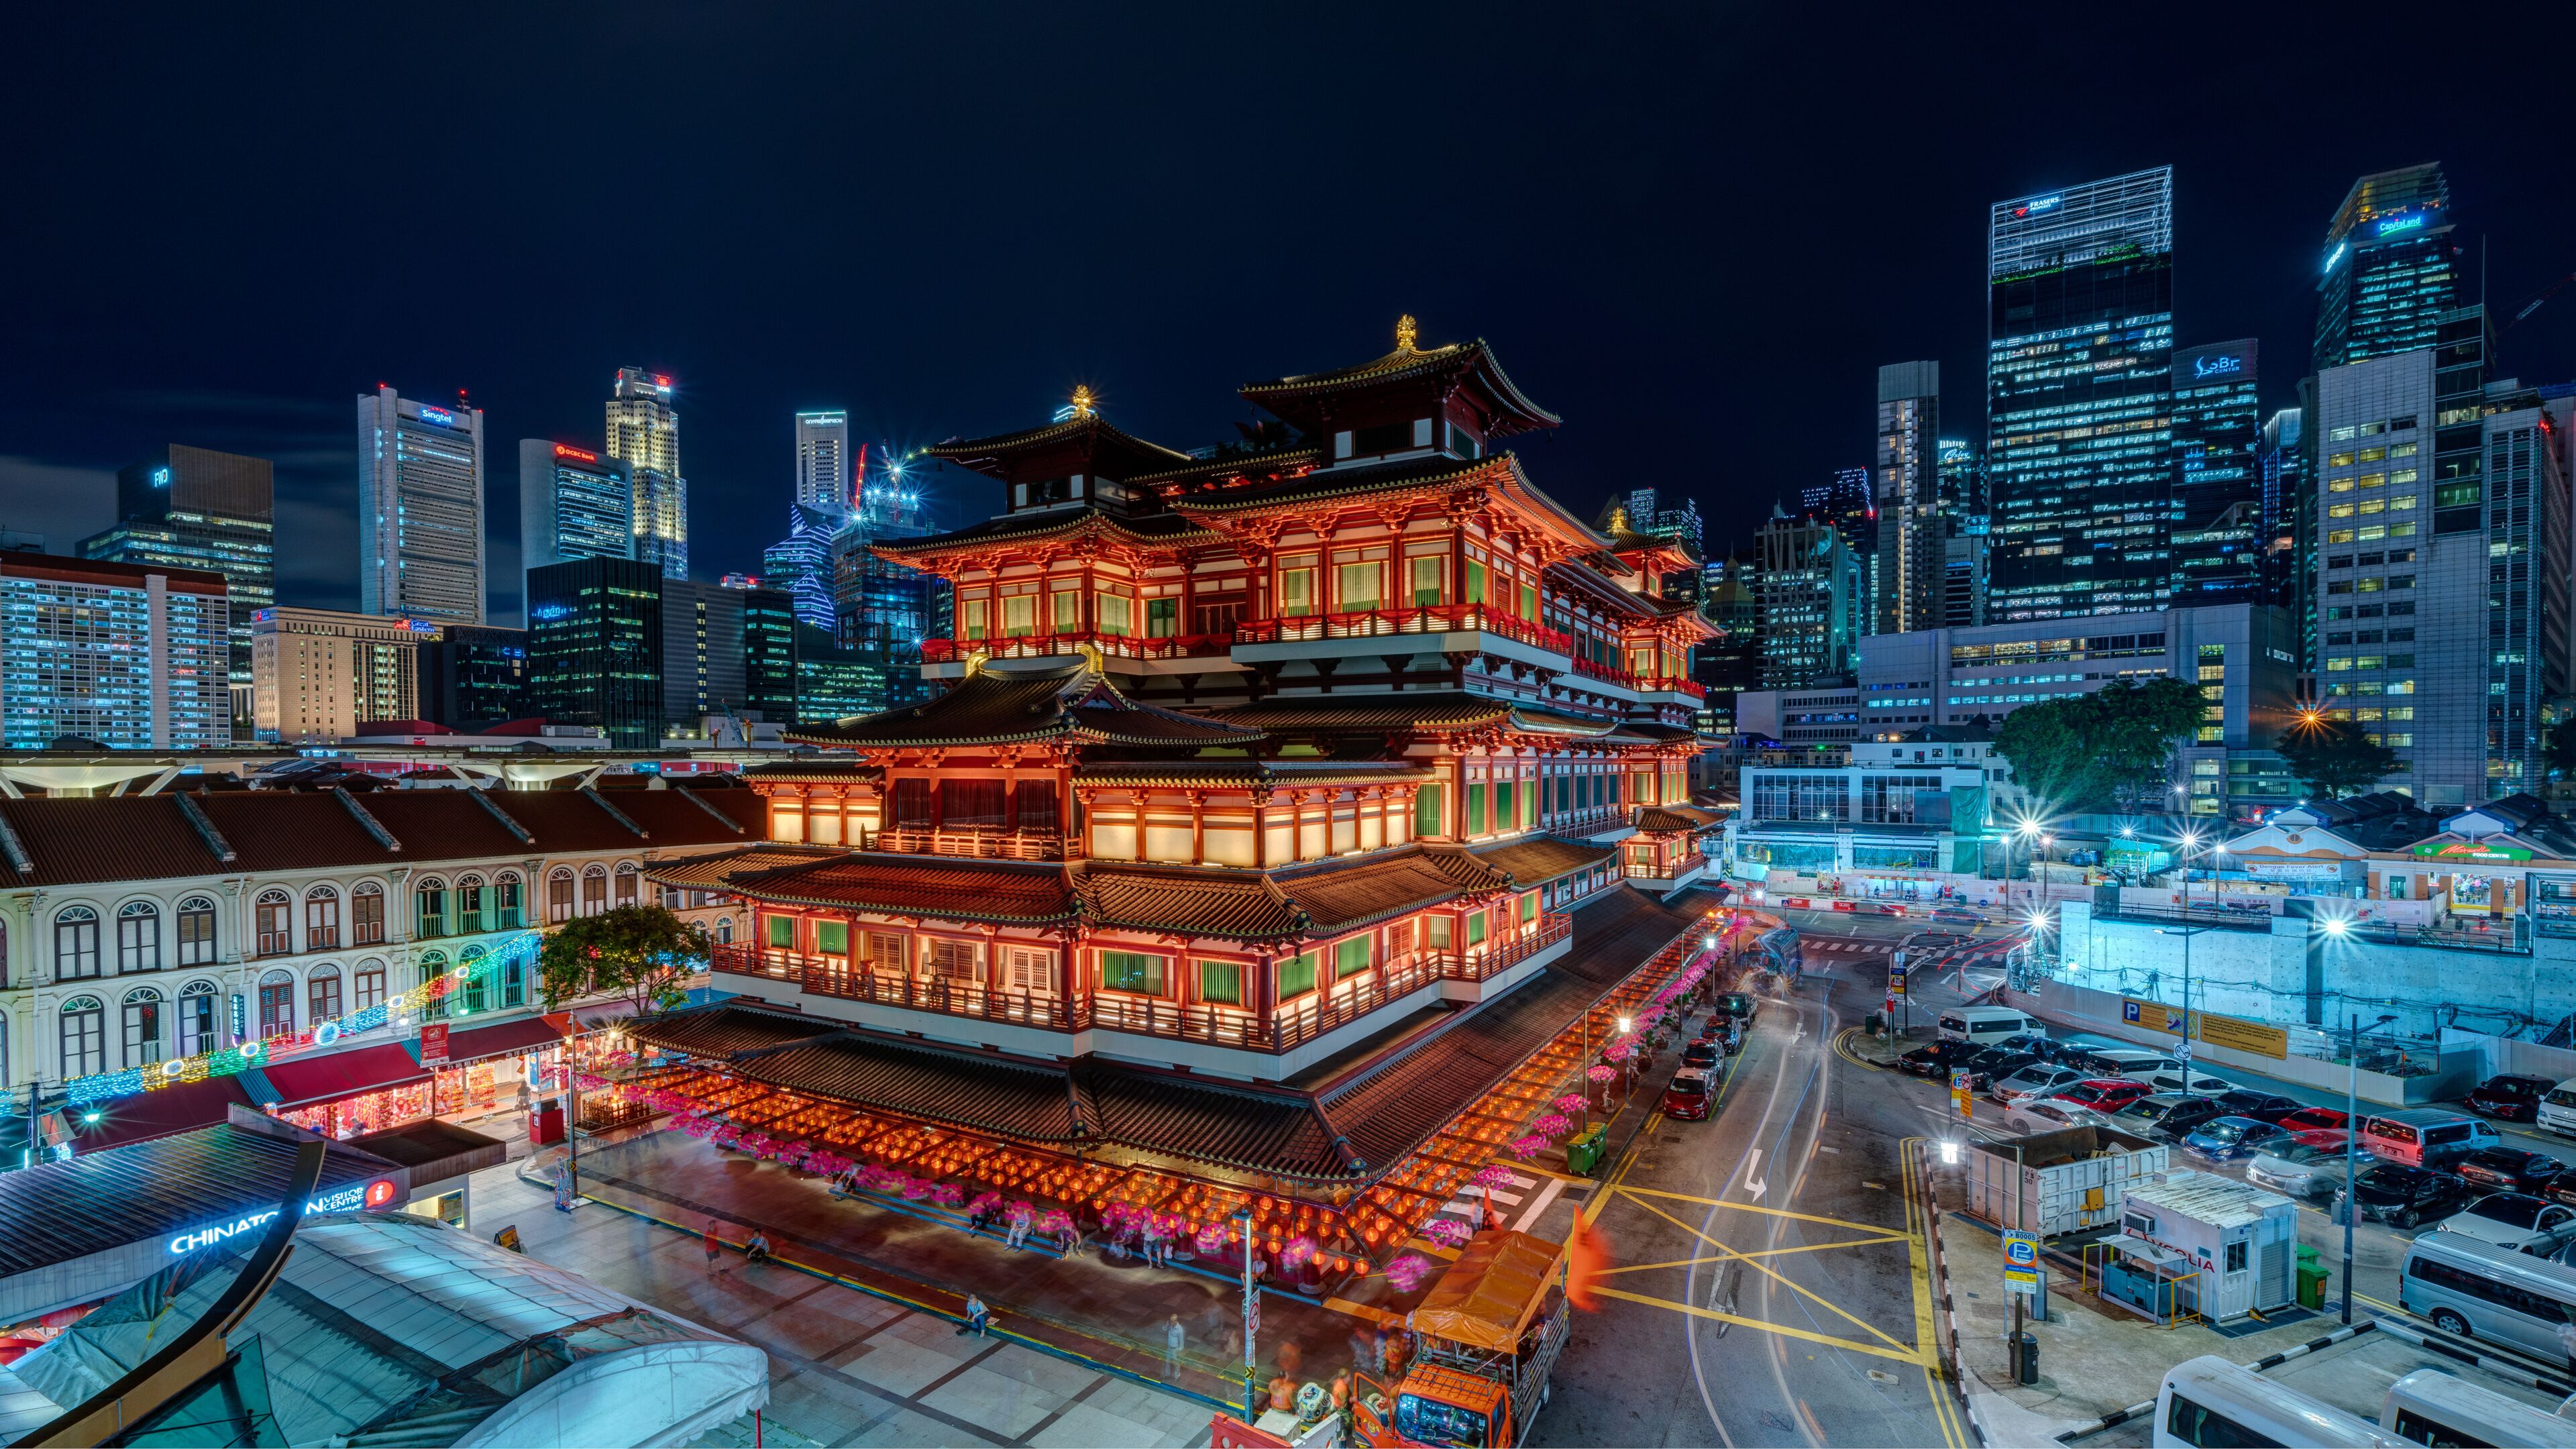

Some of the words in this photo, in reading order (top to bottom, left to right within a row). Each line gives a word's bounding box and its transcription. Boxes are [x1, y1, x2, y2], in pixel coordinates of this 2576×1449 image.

[2030, 197, 2059, 207] FRASERS
[2380, 216, 2420, 231] CapitaLand
[422, 409, 451, 423] Singtel
[1945, 449, 1969, 460] Oxley
[154, 468, 168, 487] FWD
[2438, 845, 2490, 855] Maxwell
[2127, 1003, 2138, 1020] P
[323, 1187, 364, 1203] VISITOR
[171, 1198, 323, 1253] CHINATN
[2013, 1242, 2031, 1258] P
